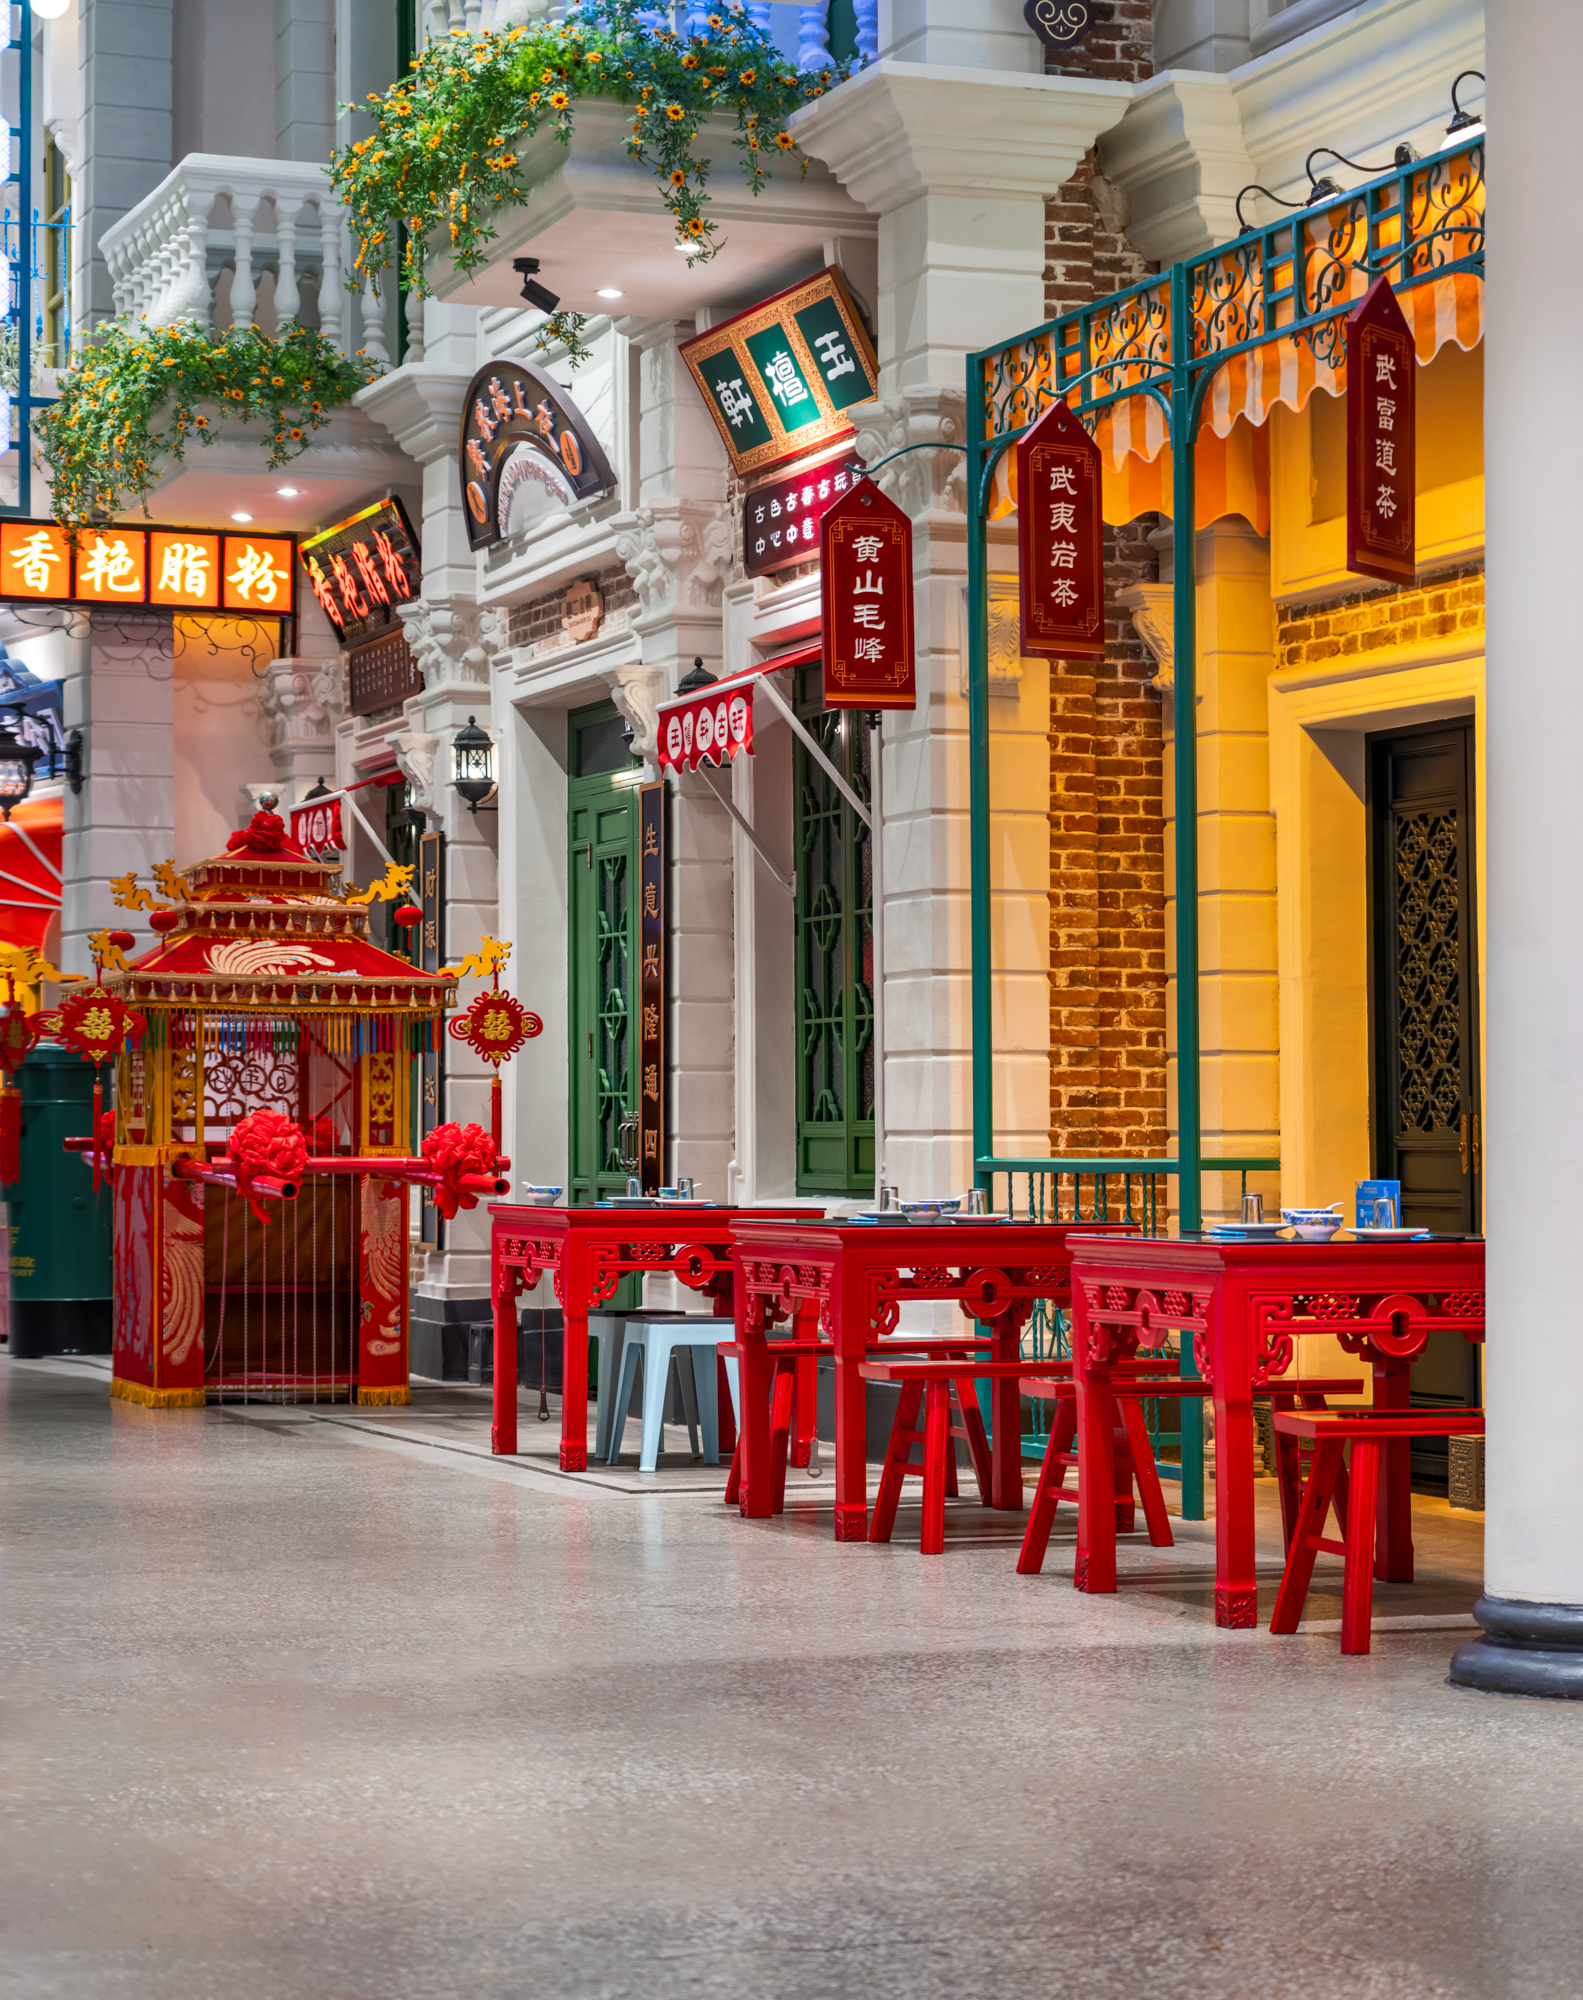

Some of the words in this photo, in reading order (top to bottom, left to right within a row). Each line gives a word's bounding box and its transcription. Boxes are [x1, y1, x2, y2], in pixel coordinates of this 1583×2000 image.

[1375, 353, 1398, 520] 武當道茶
[9, 529, 290, 604] 香艳脂粉
[308, 529, 410, 627] 香艳脂粉
[851, 534, 887, 664] 黄山毛峰
[1049, 464, 1080, 609] 武夷岩茶
[643, 822, 660, 1198] 生意兴隆通四
